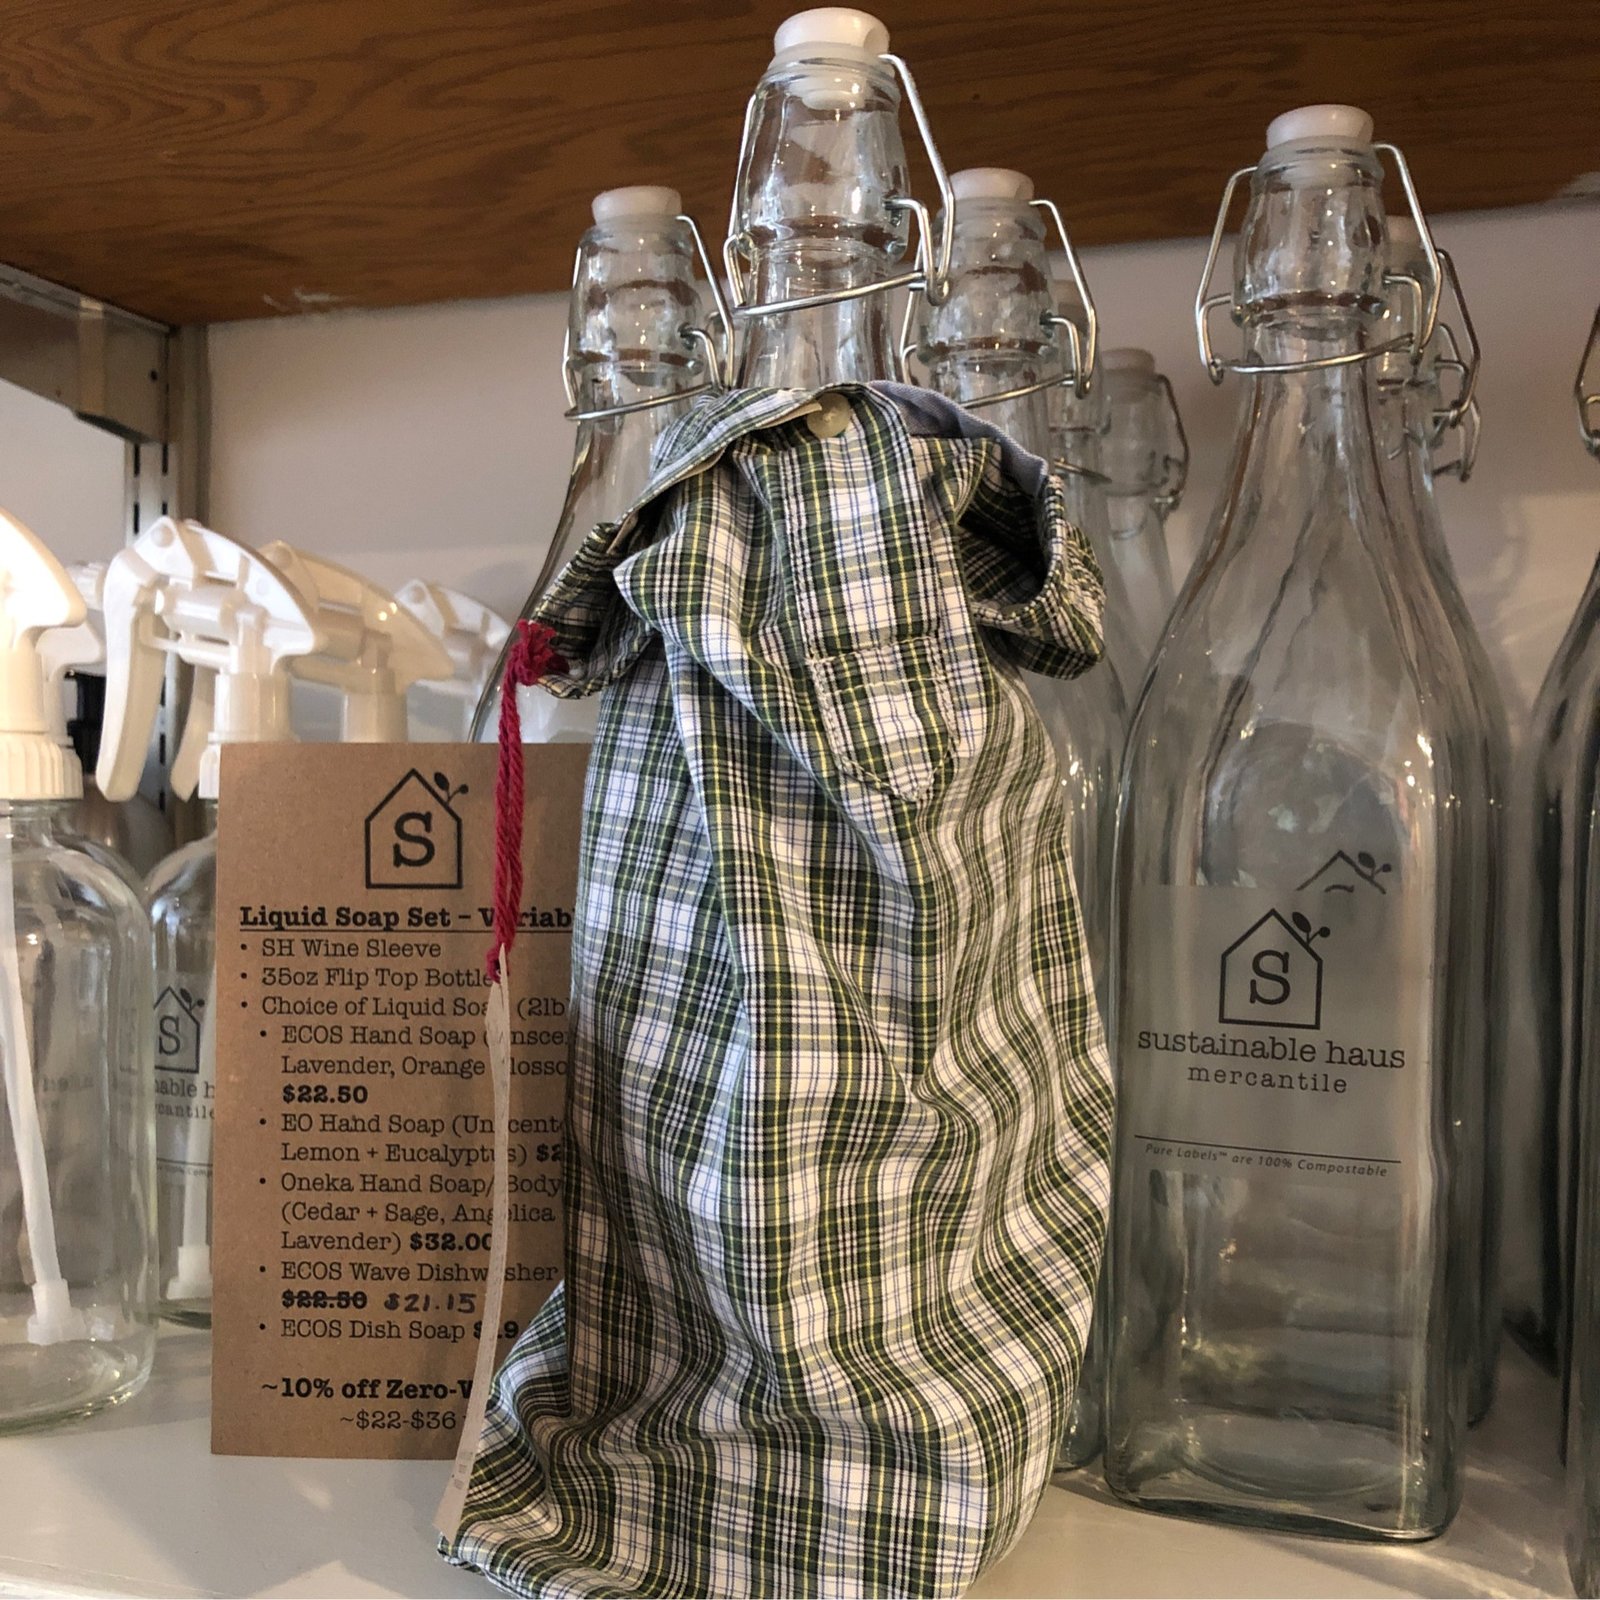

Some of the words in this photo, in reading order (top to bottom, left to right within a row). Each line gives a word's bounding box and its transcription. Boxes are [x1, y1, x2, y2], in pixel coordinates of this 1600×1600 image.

[392, 811, 435, 868] S
[240, 906, 327, 930] Liquid
[336, 906, 399, 930] Soap
[407, 907, 451, 927] Set
[478, 906, 575, 928] Vriab
[261, 938, 295, 957] SH
[301, 938, 358, 957] Wine
[366, 938, 441, 958] Sleeve
[261, 968, 318, 986] 35oz
[326, 967, 368, 991] Flip
[375, 968, 418, 991] Top
[1249, 950, 1291, 1005] S
[261, 996, 338, 1015] Choice
[345, 996, 366, 1015] of
[373, 998, 445, 1020] Liquid
[452, 998, 489, 1017] Soa
[517, 997, 570, 1020] (2lb
[281, 1025, 343, 1044] ECOS
[350, 1026, 413, 1045] Hand
[419, 1027, 476, 1049] Soap
[1138, 1030, 1316, 1063] sustainable
[1325, 1040, 1406, 1069] haus
[281, 1055, 396, 1078] Lavender,
[402, 1056, 486, 1079] Orange
[510, 1057, 568, 1075] losso
[1187, 1066, 1347, 1093] mercantile
[282, 1083, 368, 1104] $22.50
[281, 1113, 312, 1133] EO
[319, 1113, 381, 1134] Hand
[388, 1114, 445, 1137] Soap
[452, 1115, 563, 1137] (Uncent
[281, 1143, 360, 1162] Lemon
[385, 1144, 527, 1167] Eucalypts)
[536, 1143, 562, 1163] $2
[1145, 1143, 1173, 1156] Pure
[1231, 1154, 1253, 1165] are
[1257, 1155, 1293, 1169] 100%
[1297, 1159, 1388, 1177] Compostable
[281, 1172, 354, 1192] Oneka
[360, 1174, 421, 1193] Hand
[281, 1202, 360, 1226] (Cedar
[385, 1202, 445, 1225] Sage,
[451, 1203, 556, 1226] Anglica
[281, 1231, 401, 1255] Lavender)
[281, 1262, 343, 1280] ECOS
[349, 1262, 410, 1281] Wave
[417, 1263, 559, 1282] Dishwsher
[384, 1292, 478, 1315] $21.15
[281, 1319, 343, 1338] ECOS
[349, 1319, 400, 1338] Dish
[408, 1320, 465, 1343] Soap
[341, 1379, 381, 1399] off
[386, 1379, 473, 1400] Zero-W
[340, 1410, 456, 1429] ~$22-$36
